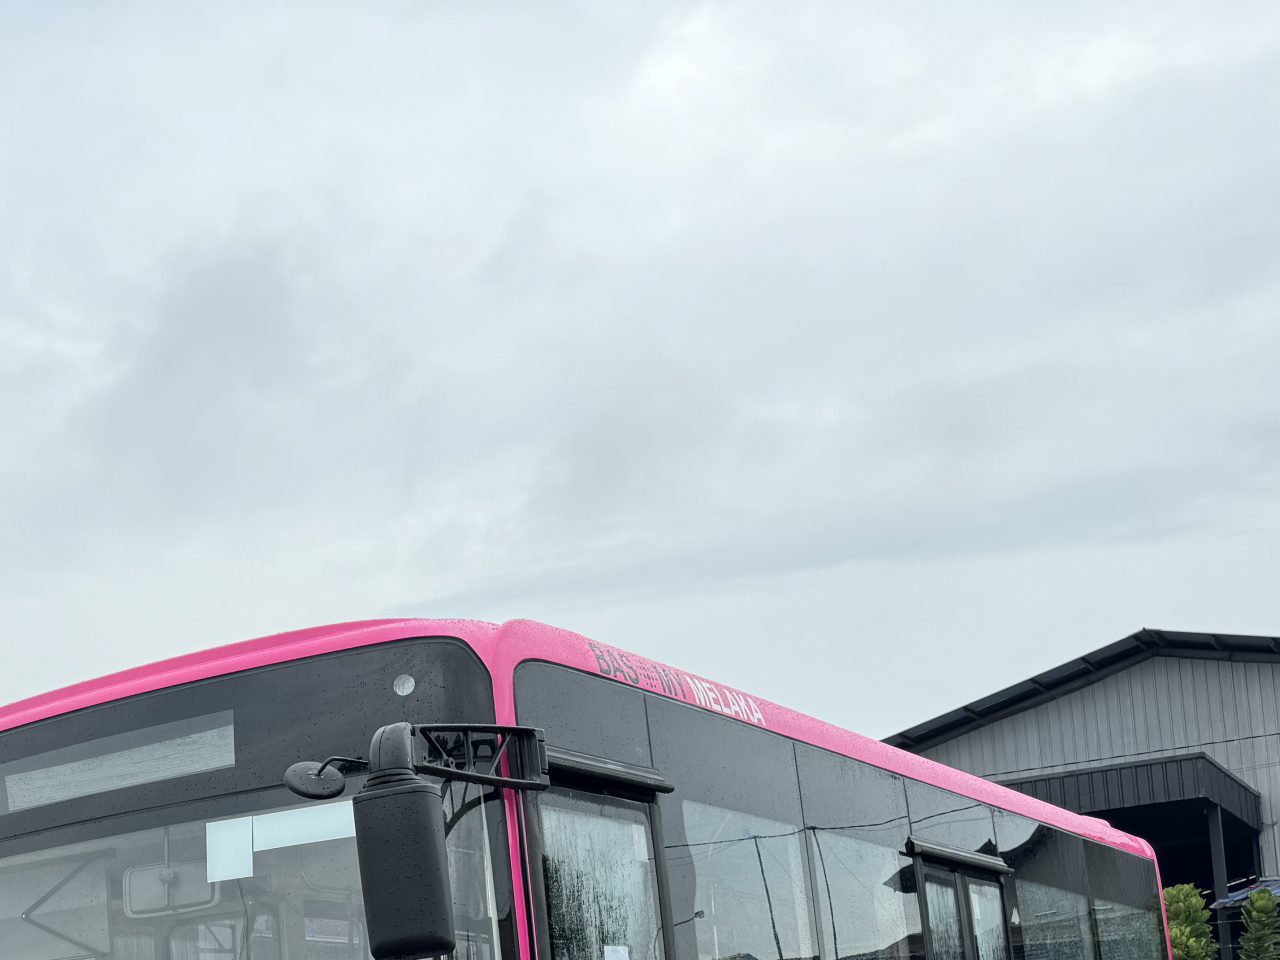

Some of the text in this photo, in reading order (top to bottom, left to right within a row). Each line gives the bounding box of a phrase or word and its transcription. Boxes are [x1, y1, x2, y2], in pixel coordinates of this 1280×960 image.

[588, 642, 766, 726] BAS MY MELAKA
